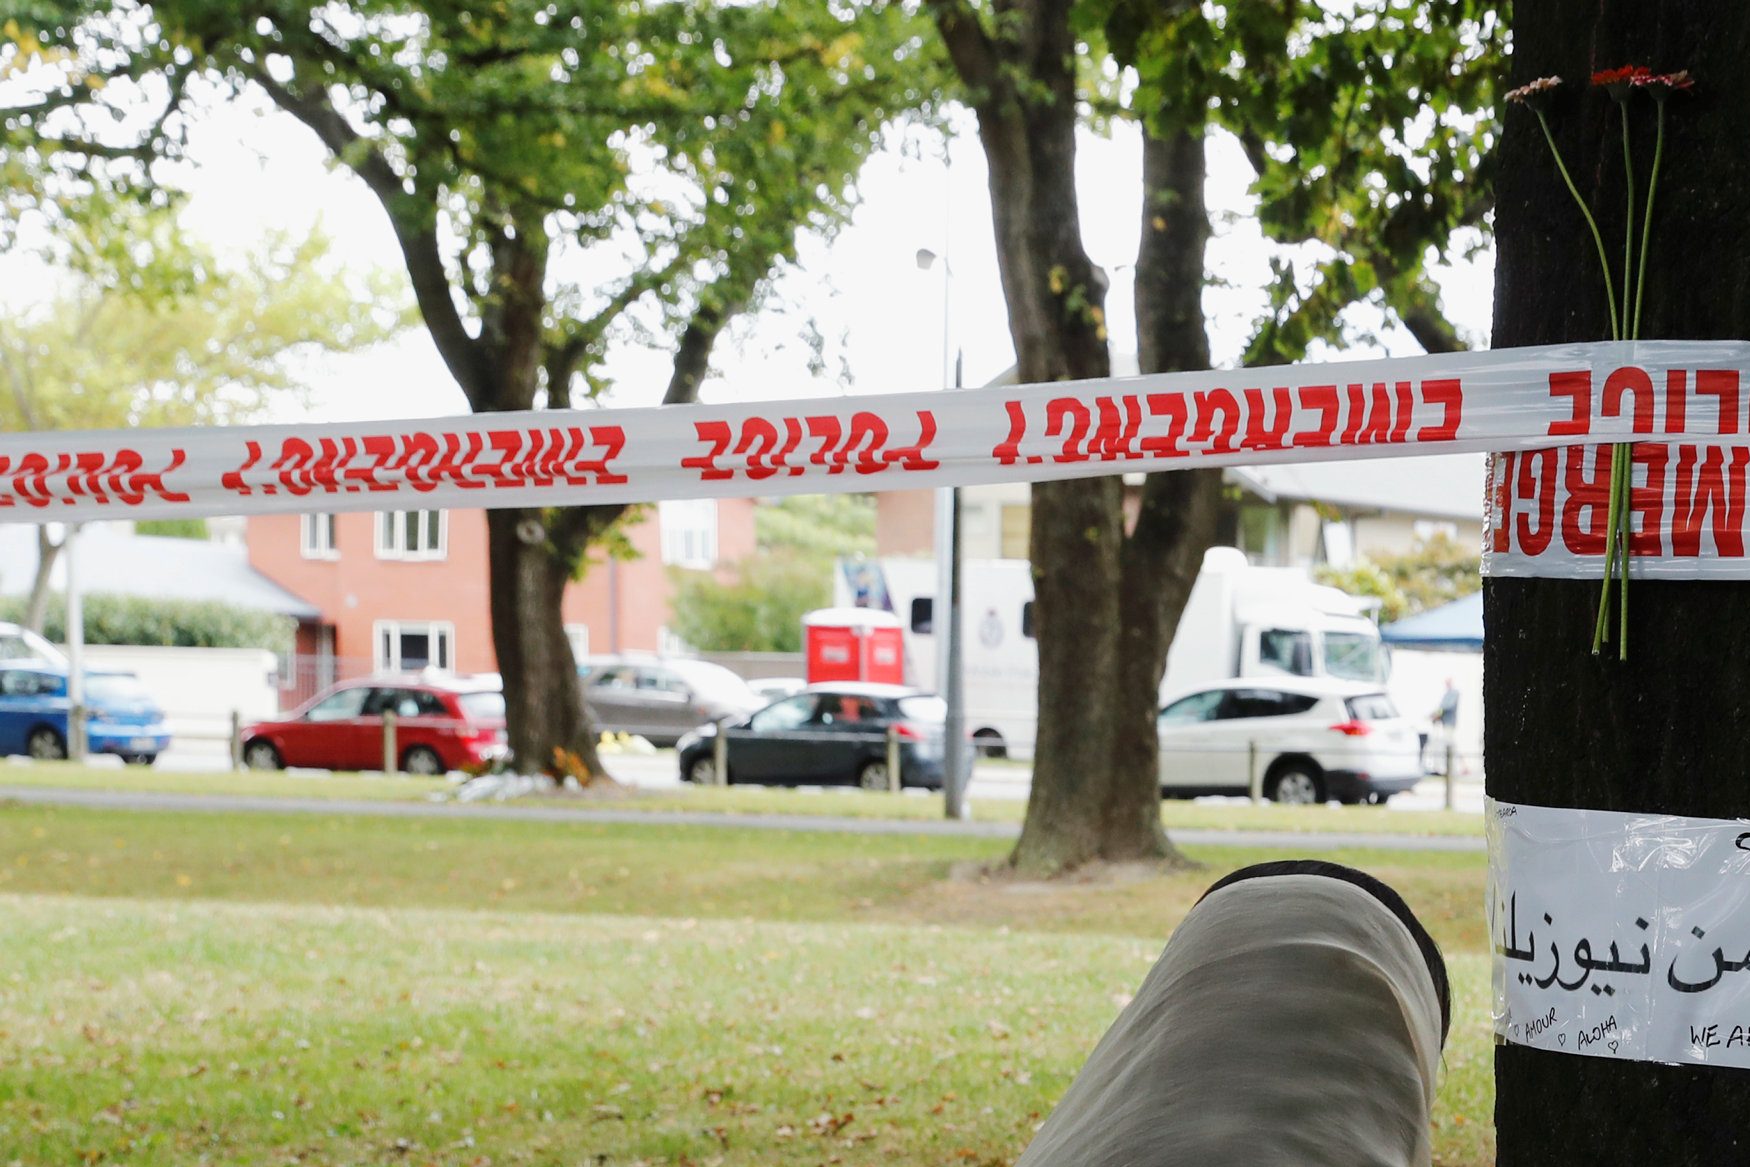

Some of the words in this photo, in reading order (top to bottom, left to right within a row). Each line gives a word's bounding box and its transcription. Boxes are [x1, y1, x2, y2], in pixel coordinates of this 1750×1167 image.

[681, 410, 940, 481] POLICE
[992, 378, 1463, 466] EMERGENCY
[1523, 1006, 1558, 1043] AMOUR
[1577, 1014, 1619, 1051] ALOHA
[1690, 1024, 1721, 1049] WE
